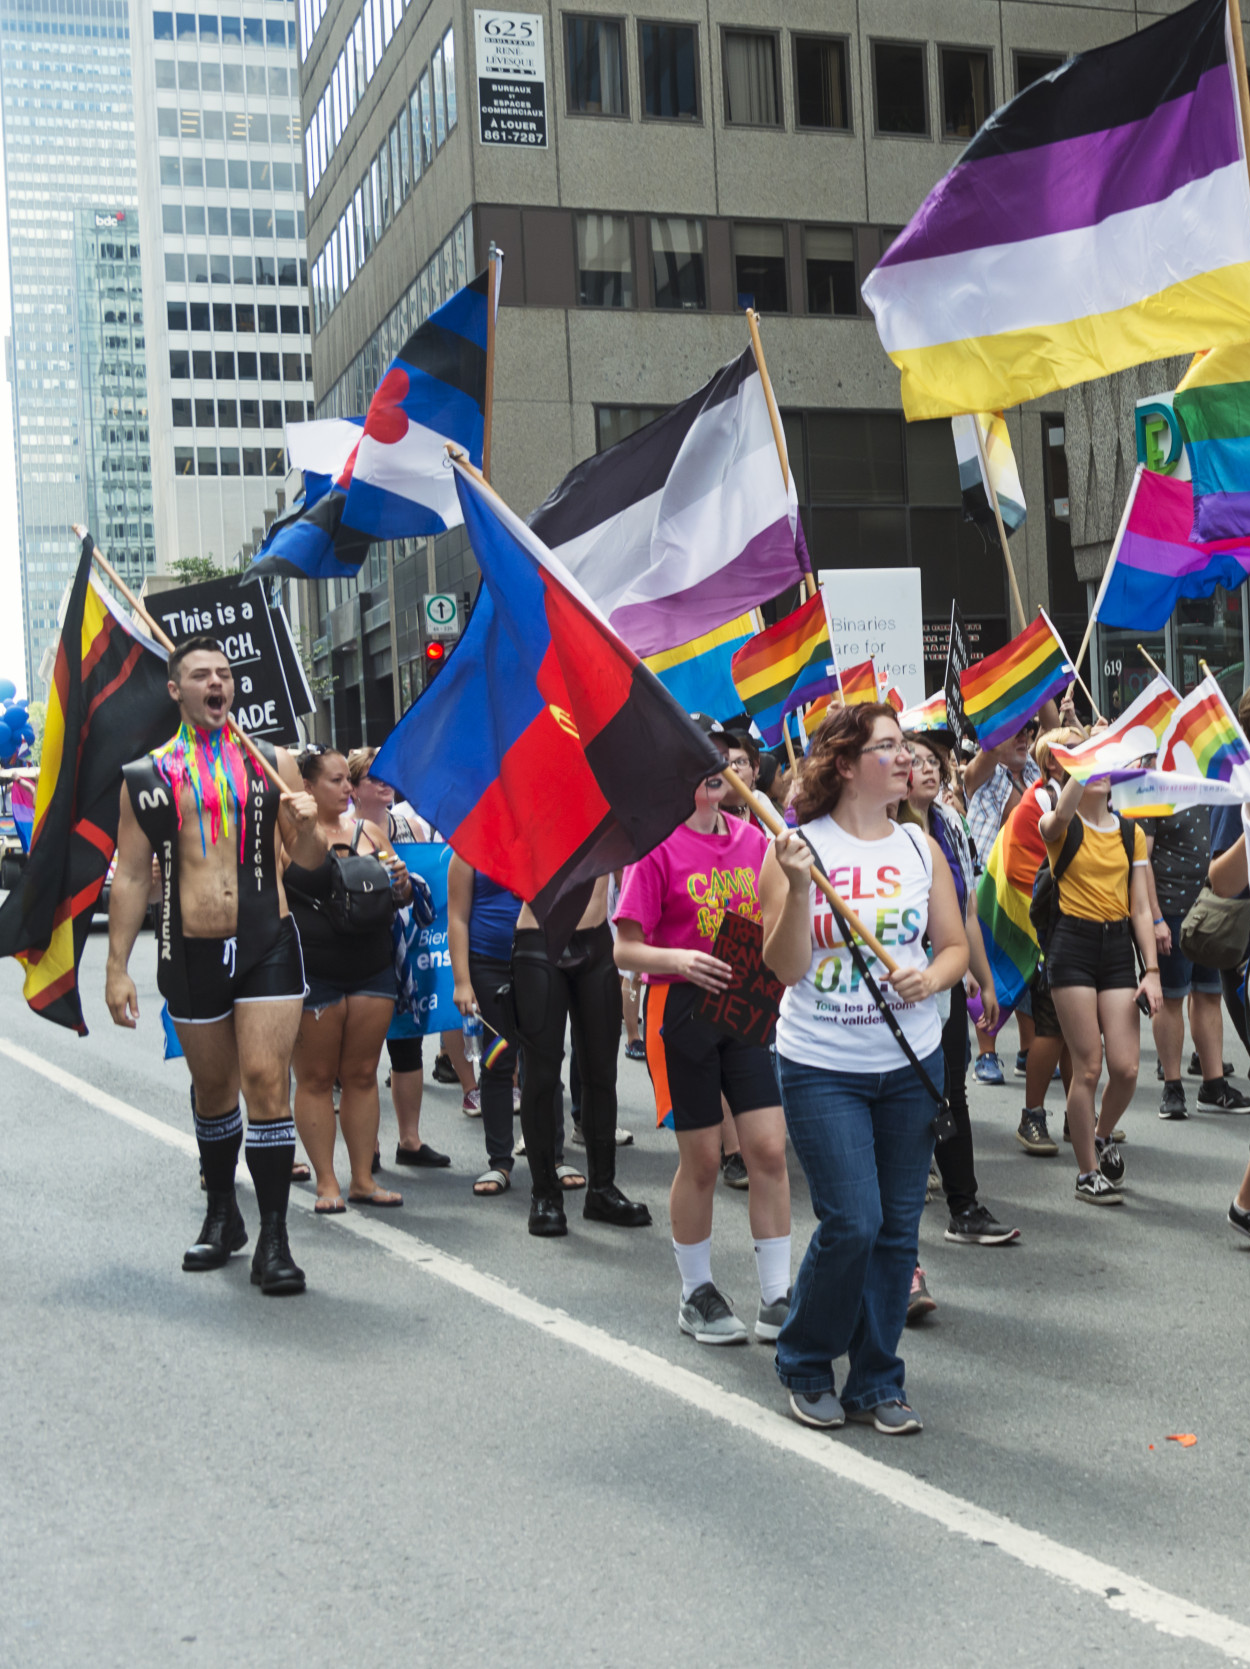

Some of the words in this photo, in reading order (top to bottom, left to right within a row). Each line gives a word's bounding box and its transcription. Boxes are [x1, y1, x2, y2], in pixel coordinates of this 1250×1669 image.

[484, 17, 533, 39] 625
[491, 83, 532, 95] BUREAUX
[481, 105, 544, 118] COMMERCIAUX
[493, 98, 532, 109] ESPACES
[500, 119, 537, 131] LOUER
[484, 129, 543, 144] 861-7287
[95, 214, 118, 227] bdc
[162, 607, 213, 638] This
[216, 602, 236, 626] is
[241, 602, 254, 620] a
[831, 615, 897, 634] Binaries
[835, 641, 860, 656] are
[866, 637, 886, 654] for
[1104, 659, 1122, 677] 619
[241, 675, 253, 694] a
[251, 779, 264, 892] Montréal
[687, 866, 759, 905] CAMP
[161, 840, 172, 961] RUBBER
[815, 1000, 841, 1013] Tous
[844, 1001, 863, 1013] les
[867, 1000, 917, 1013] prnoms
[813, 1014, 838, 1025] sont
